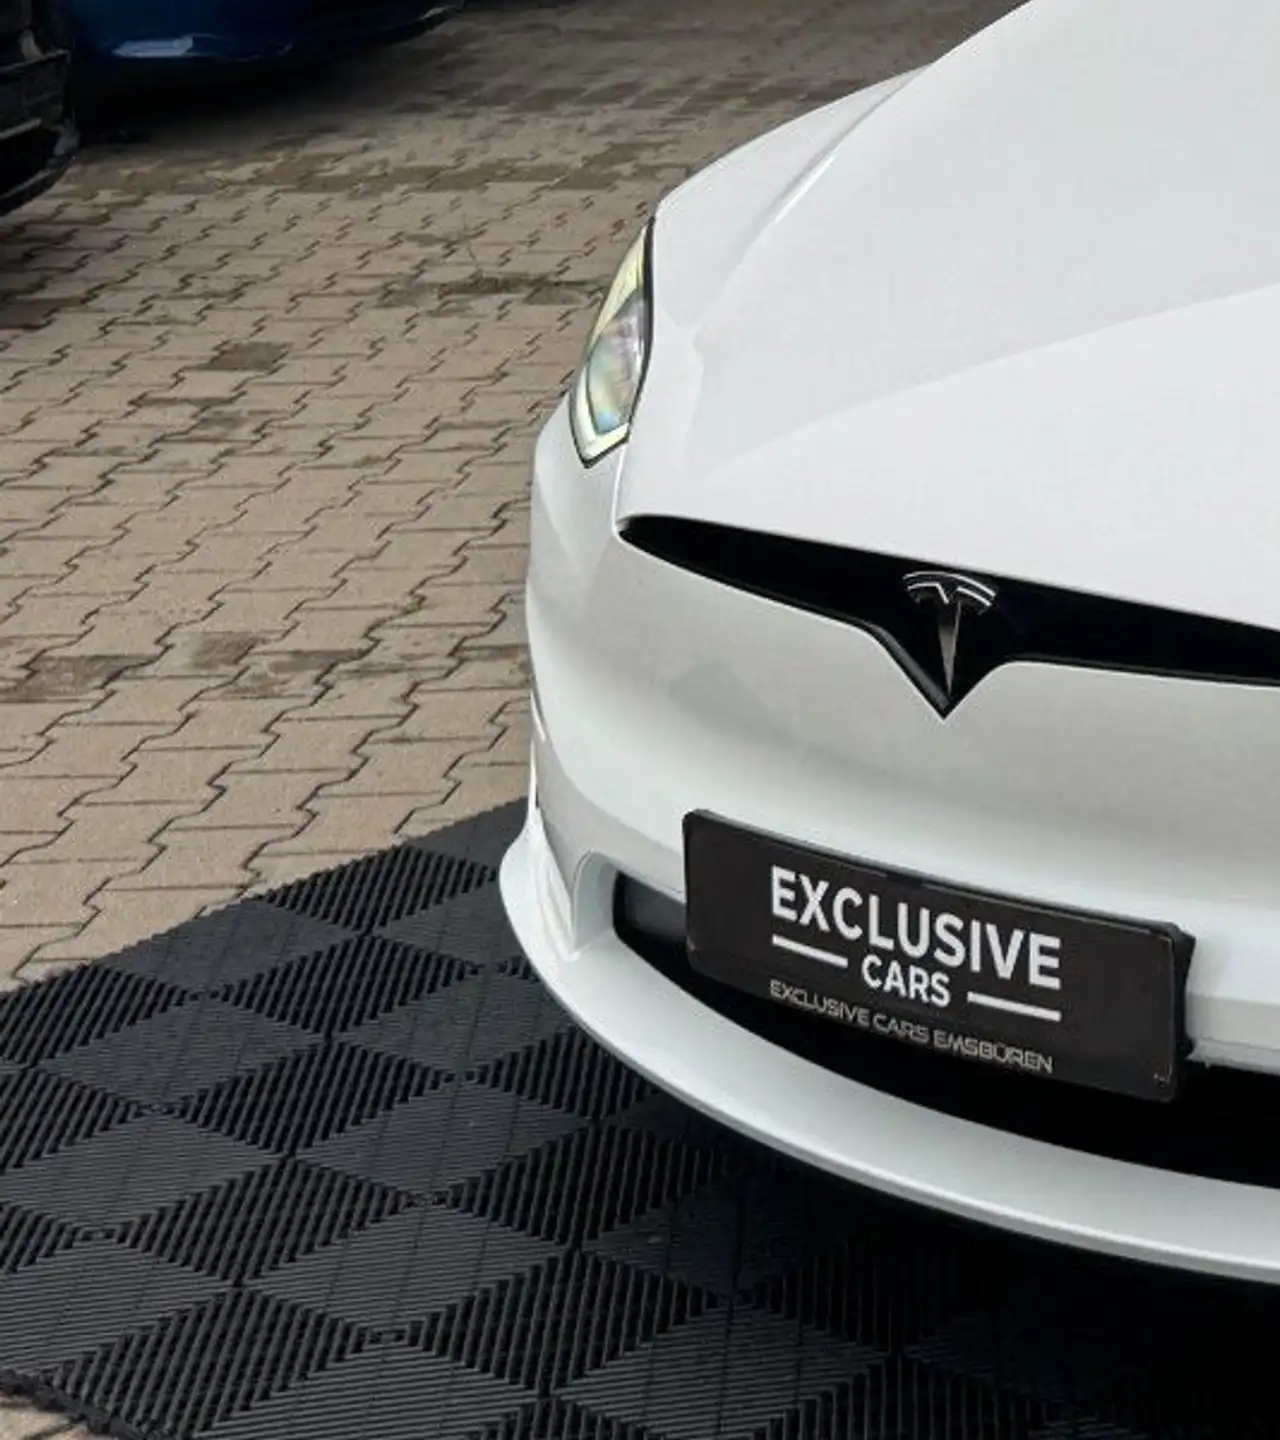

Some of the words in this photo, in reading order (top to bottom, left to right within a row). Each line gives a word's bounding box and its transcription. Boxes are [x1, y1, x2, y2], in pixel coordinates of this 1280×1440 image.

[771, 864, 1062, 990] EXCLUSIVE
[769, 979, 871, 1026] EXCLUSIVE
[873, 1013, 929, 1043] CARS
[933, 1029, 1054, 1074] EMSBÜREN
[861, 954, 951, 1007] CARS
